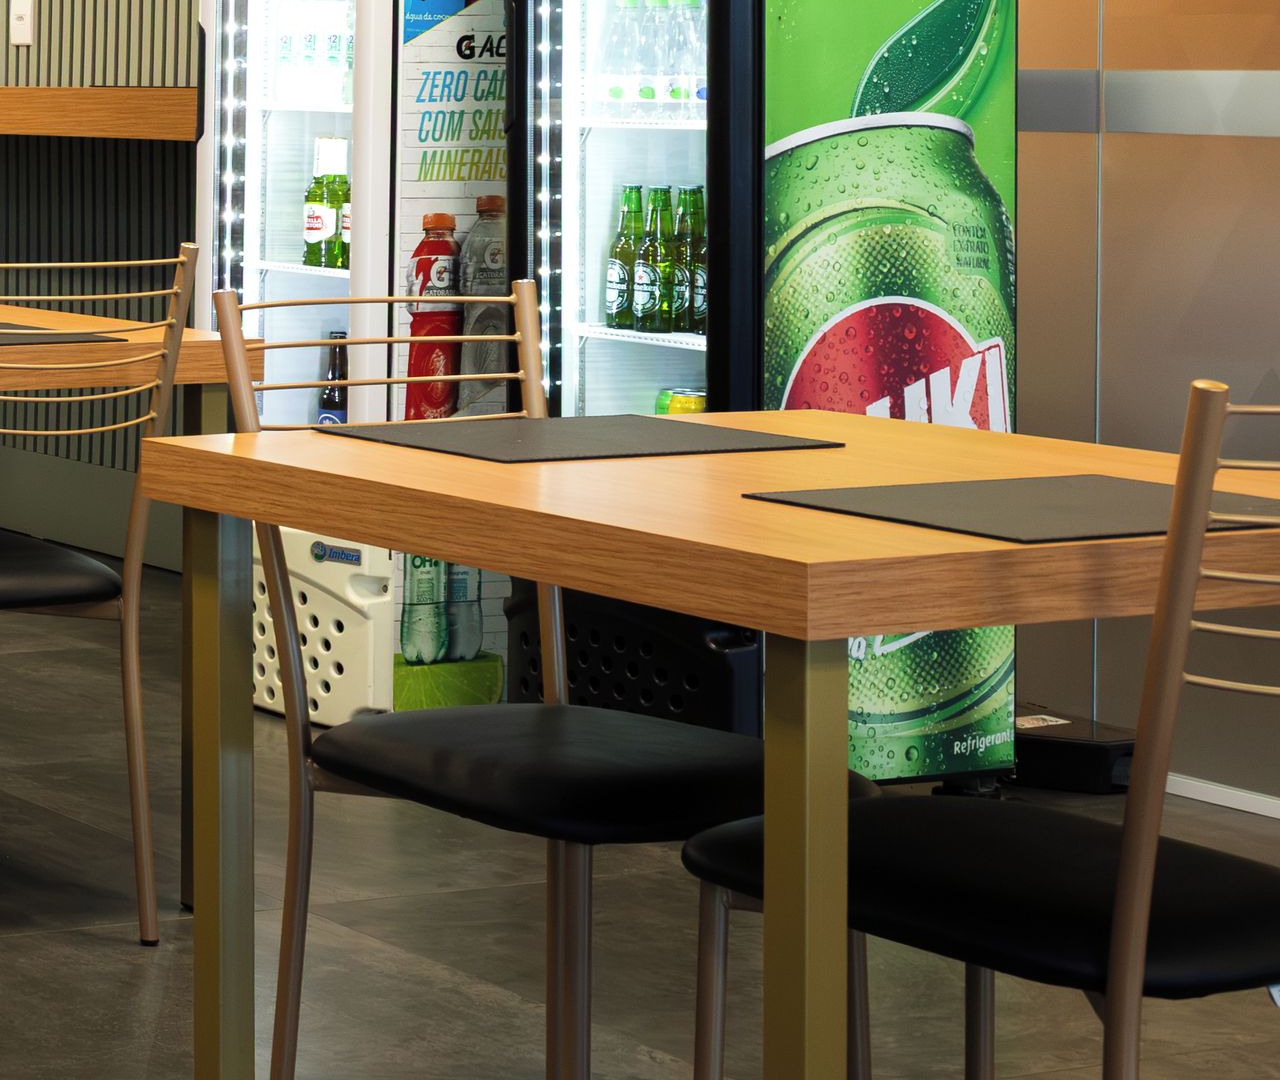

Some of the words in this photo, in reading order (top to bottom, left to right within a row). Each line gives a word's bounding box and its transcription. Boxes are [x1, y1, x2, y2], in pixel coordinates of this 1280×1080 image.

[415, 69, 469, 103] ZERO
[418, 109, 465, 143] COM
[417, 147, 507, 182] MINERAIS
[328, 548, 361, 563] Imbera
